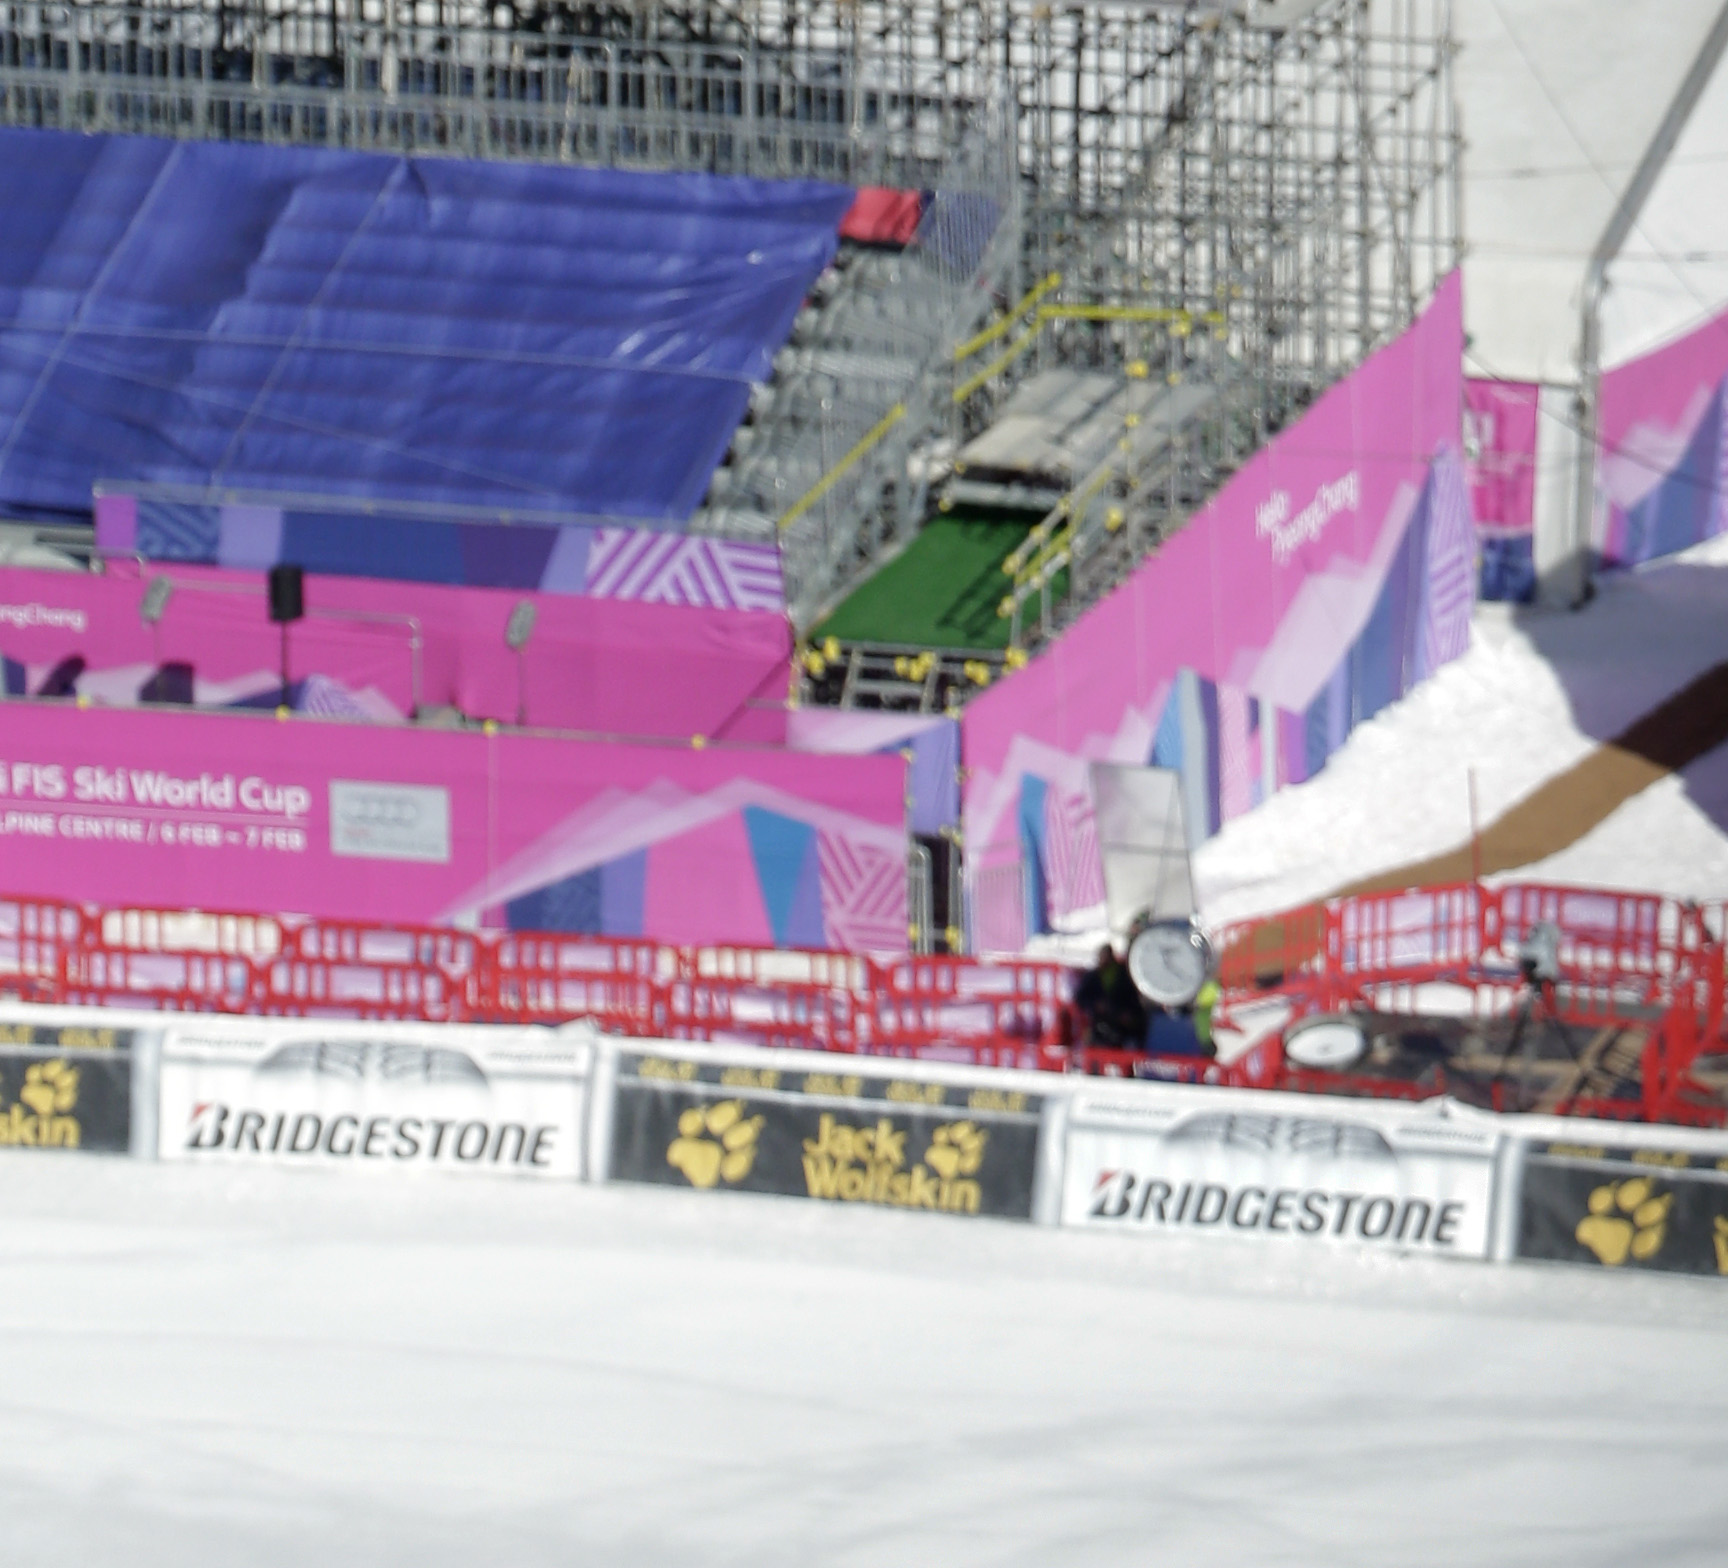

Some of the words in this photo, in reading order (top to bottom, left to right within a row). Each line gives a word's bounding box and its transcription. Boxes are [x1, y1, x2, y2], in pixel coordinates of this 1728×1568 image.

[11, 761, 68, 799] FIS
[73, 765, 128, 801] Ski
[130, 769, 235, 810] World
[239, 776, 311, 819] Cup
[58, 814, 145, 843] CENTRE
[178, 822, 222, 847] FEB
[262, 828, 307, 852] FEB
[186, 1102, 559, 1165] BRIDGESTONE
[802, 1113, 908, 1164] Jack
[802, 1153, 982, 1213] Wolfskin
[1090, 1169, 1463, 1244] BRIDGESTONE
